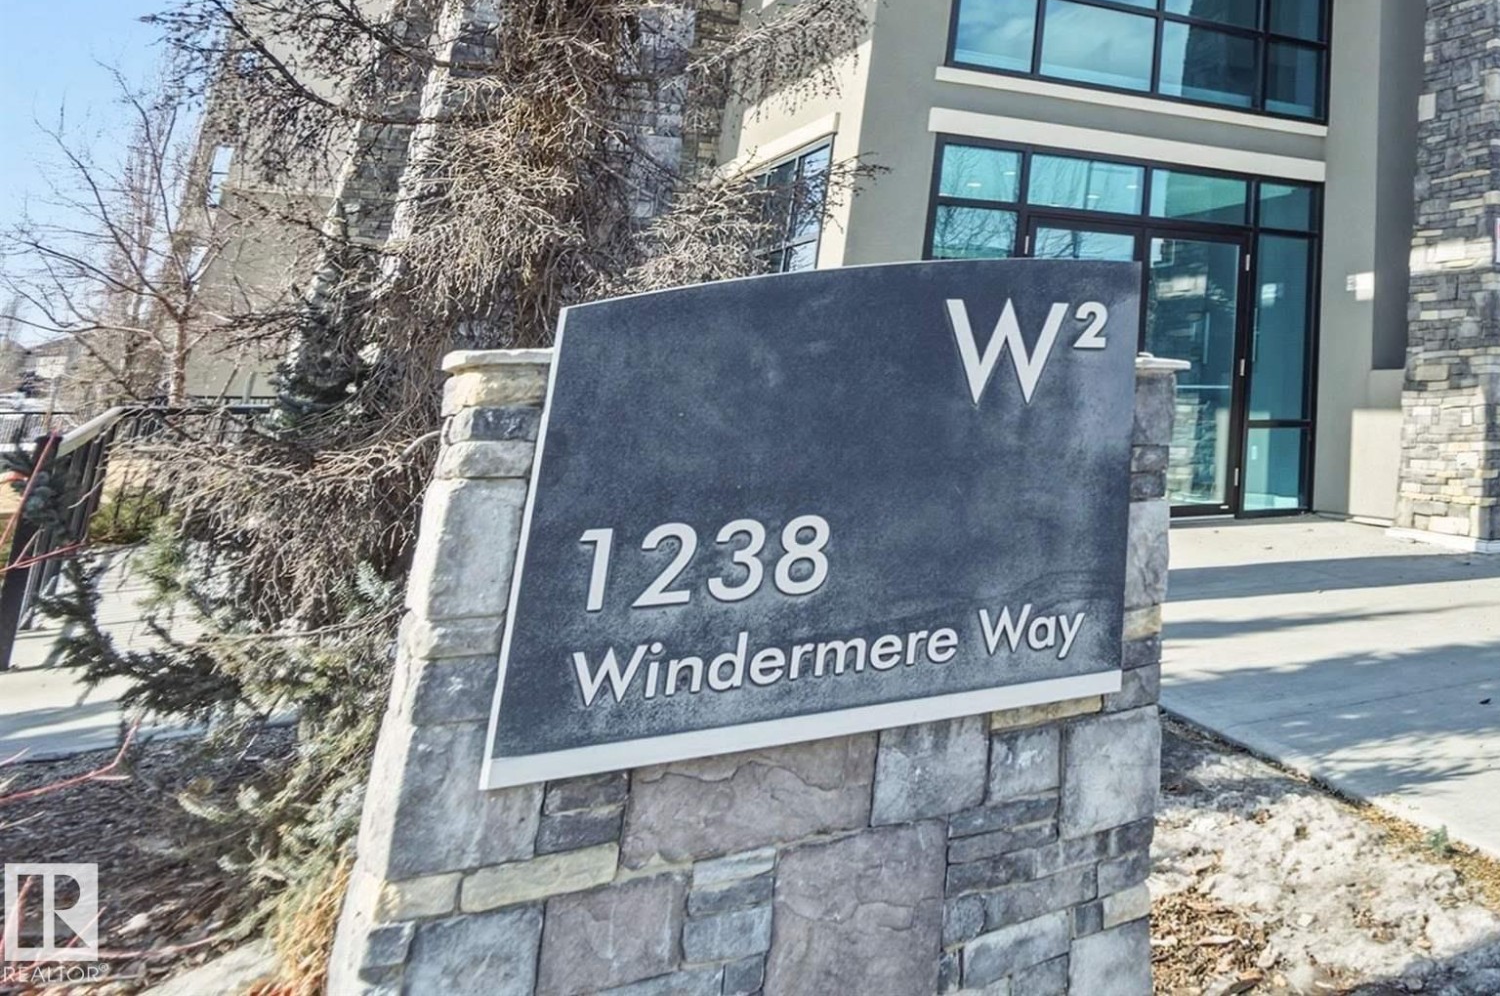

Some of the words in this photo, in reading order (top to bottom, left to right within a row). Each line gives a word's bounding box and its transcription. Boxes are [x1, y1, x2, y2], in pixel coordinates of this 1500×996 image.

[578, 515, 831, 611] 1238
[572, 632, 958, 706] Windermere
[978, 603, 1085, 659] Way
